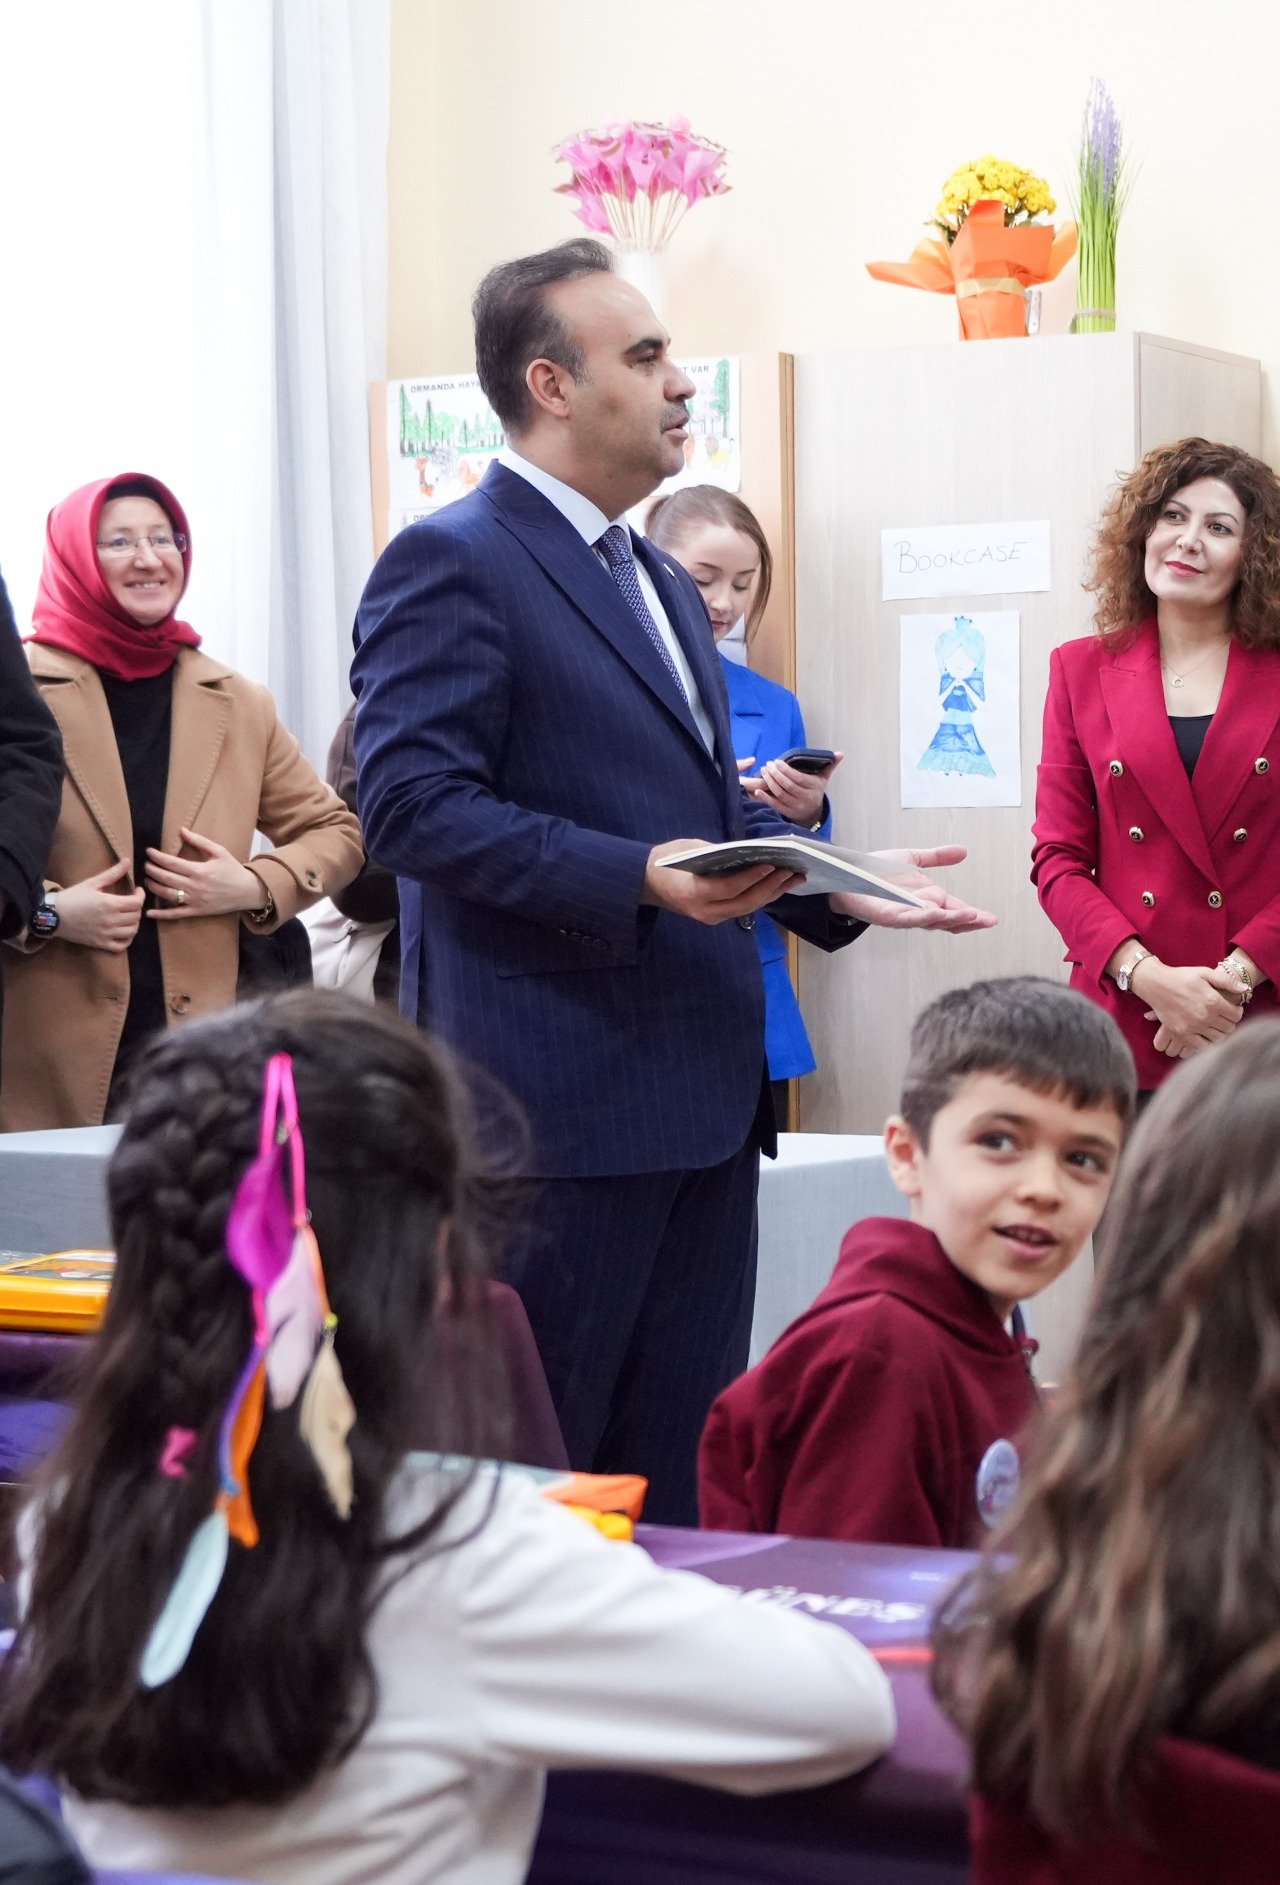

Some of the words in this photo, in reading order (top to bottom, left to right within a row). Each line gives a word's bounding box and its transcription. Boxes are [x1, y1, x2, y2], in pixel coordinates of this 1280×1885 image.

[691, 365, 709, 373] VAR
[410, 383, 455, 394] ORMANDA
[894, 541, 1028, 573] BOOKCASE
